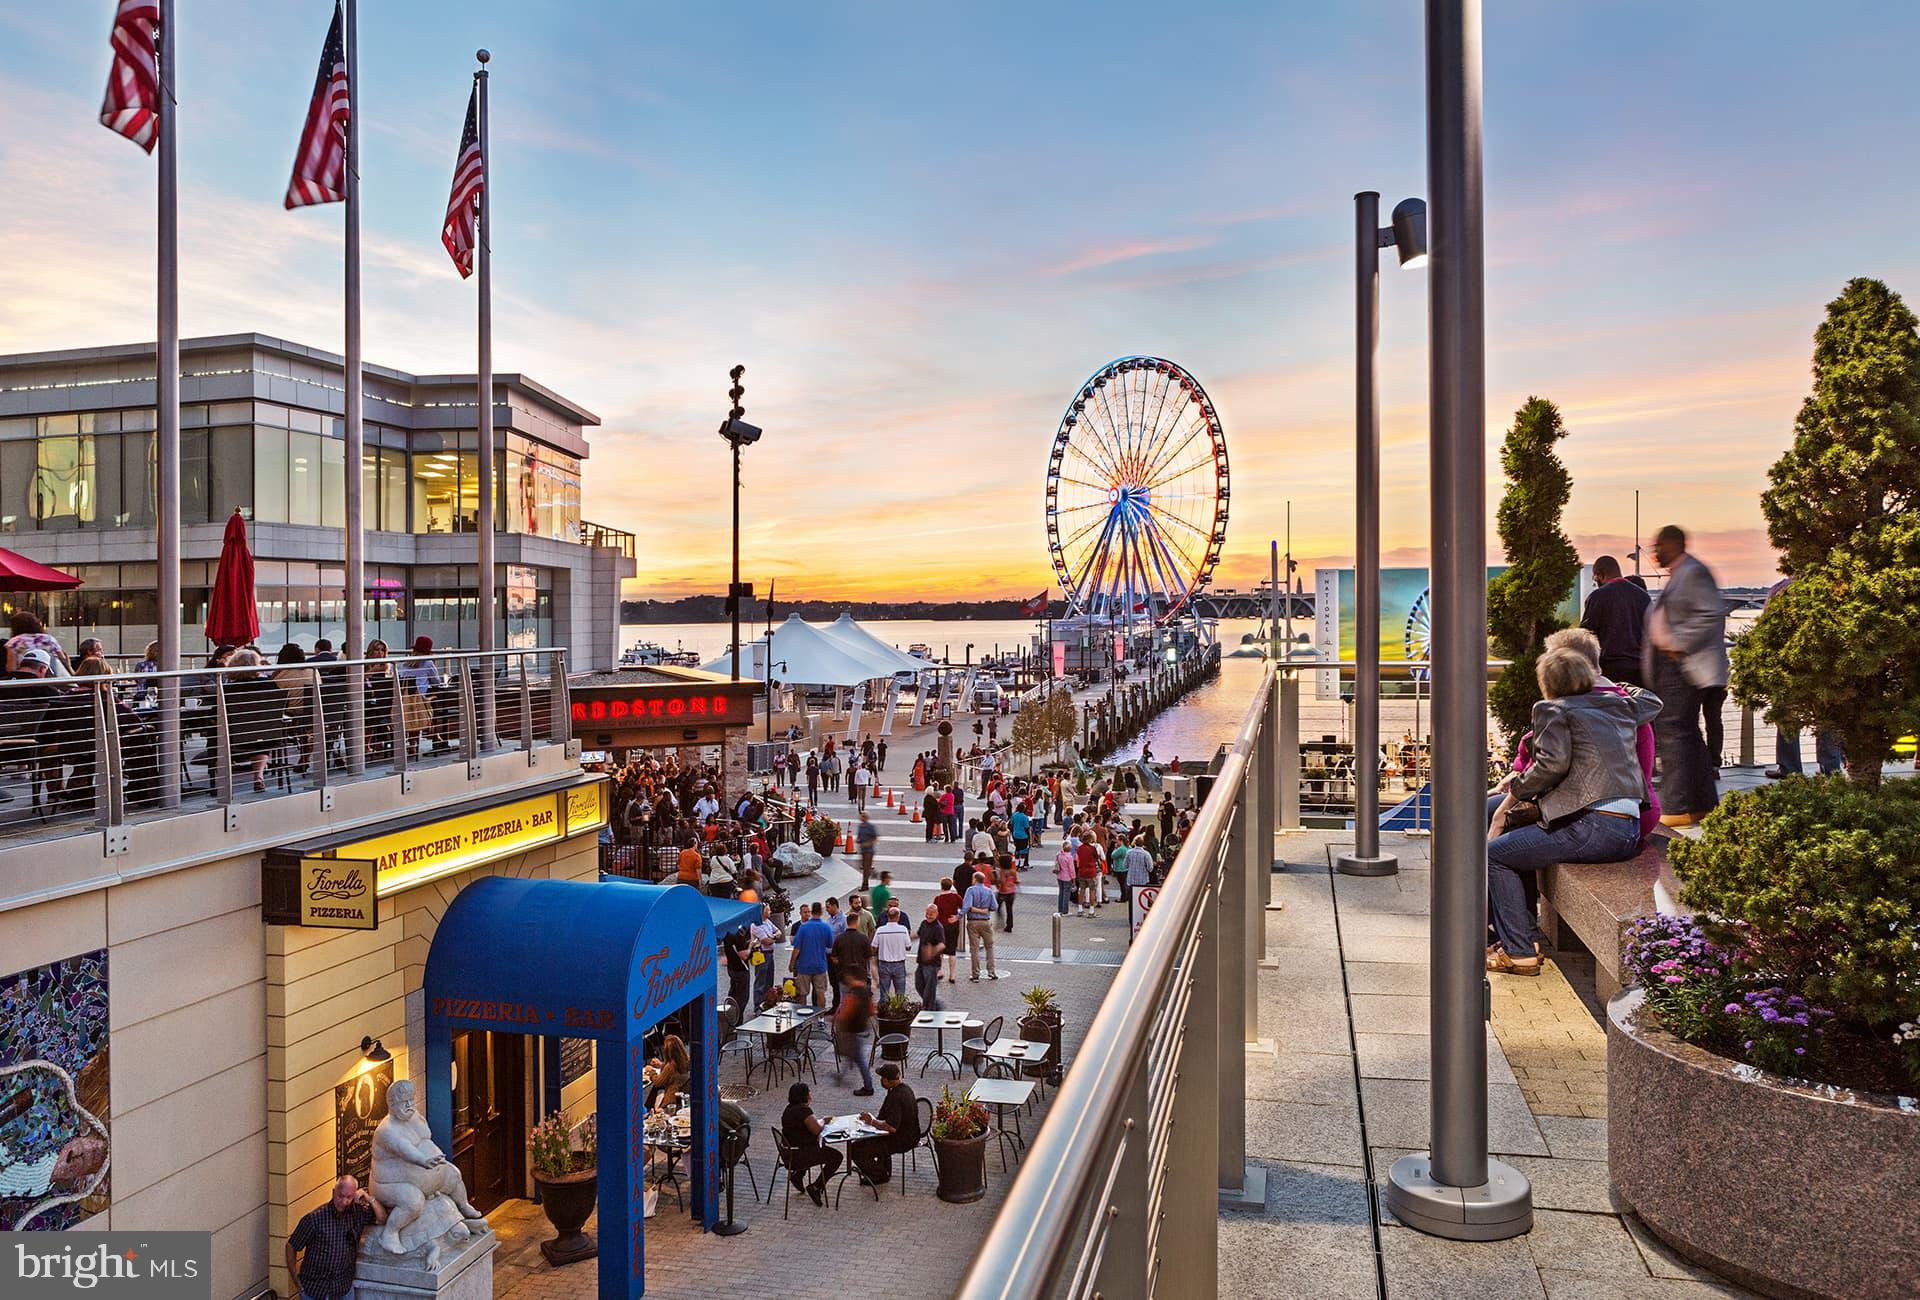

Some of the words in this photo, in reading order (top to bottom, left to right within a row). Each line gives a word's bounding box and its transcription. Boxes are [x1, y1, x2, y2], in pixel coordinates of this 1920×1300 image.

[571, 696, 727, 720] REDSTONE
[377, 852, 398, 872] AN
[402, 835, 461, 864] KITCHEN
[472, 818, 523, 845] PIZZERIA
[532, 810, 553, 827] BAR
[307, 868, 366, 895] Fiorella
[310, 906, 365, 919] PIZZERIA
[633, 928, 712, 1019] Fiorella
[431, 997, 540, 1025] PIZZERIA
[563, 1007, 616, 1030] BAR
[630, 1045, 640, 1203] PIZZERIA
[632, 1220, 641, 1281] BAR
